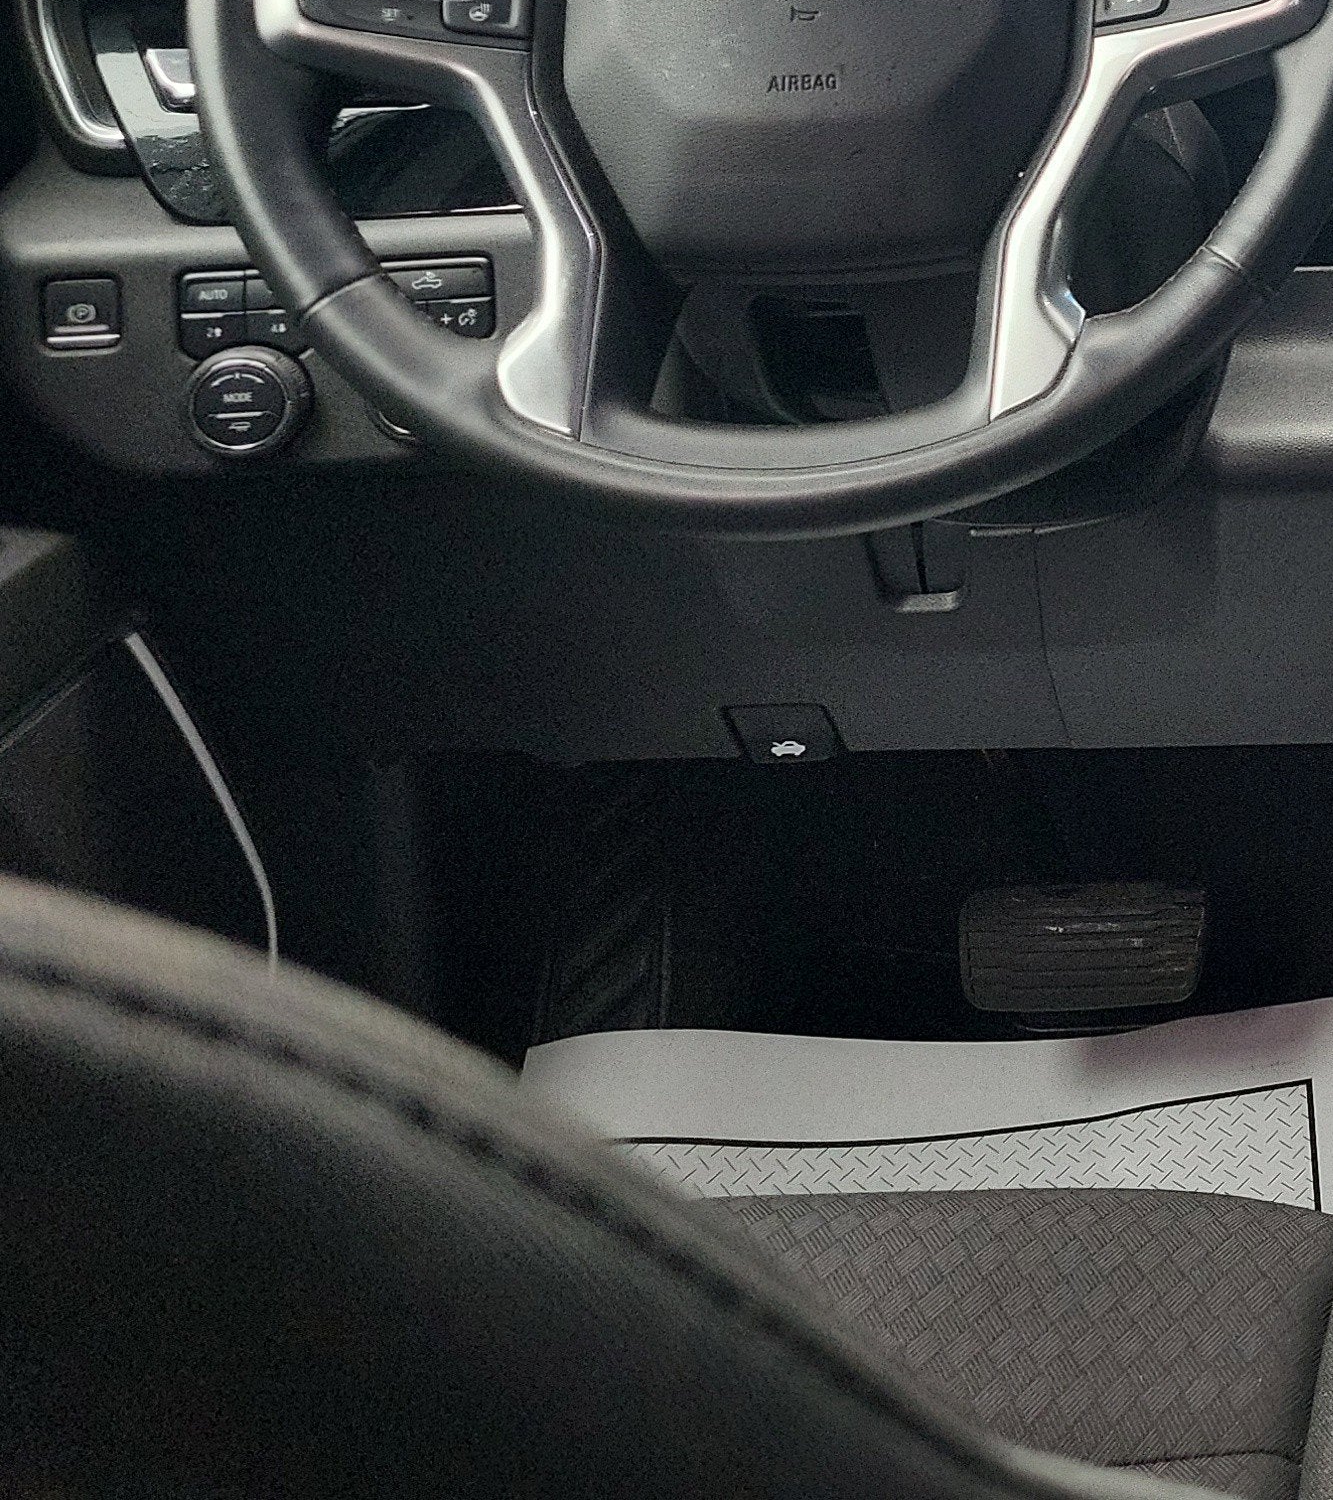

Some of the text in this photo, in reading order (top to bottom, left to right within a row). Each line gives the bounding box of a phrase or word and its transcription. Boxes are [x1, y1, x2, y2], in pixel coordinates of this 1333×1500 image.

[767, 73, 838, 93] AIRBAG
[199, 288, 228, 300] AUTO
[222, 391, 253, 403] MODE
